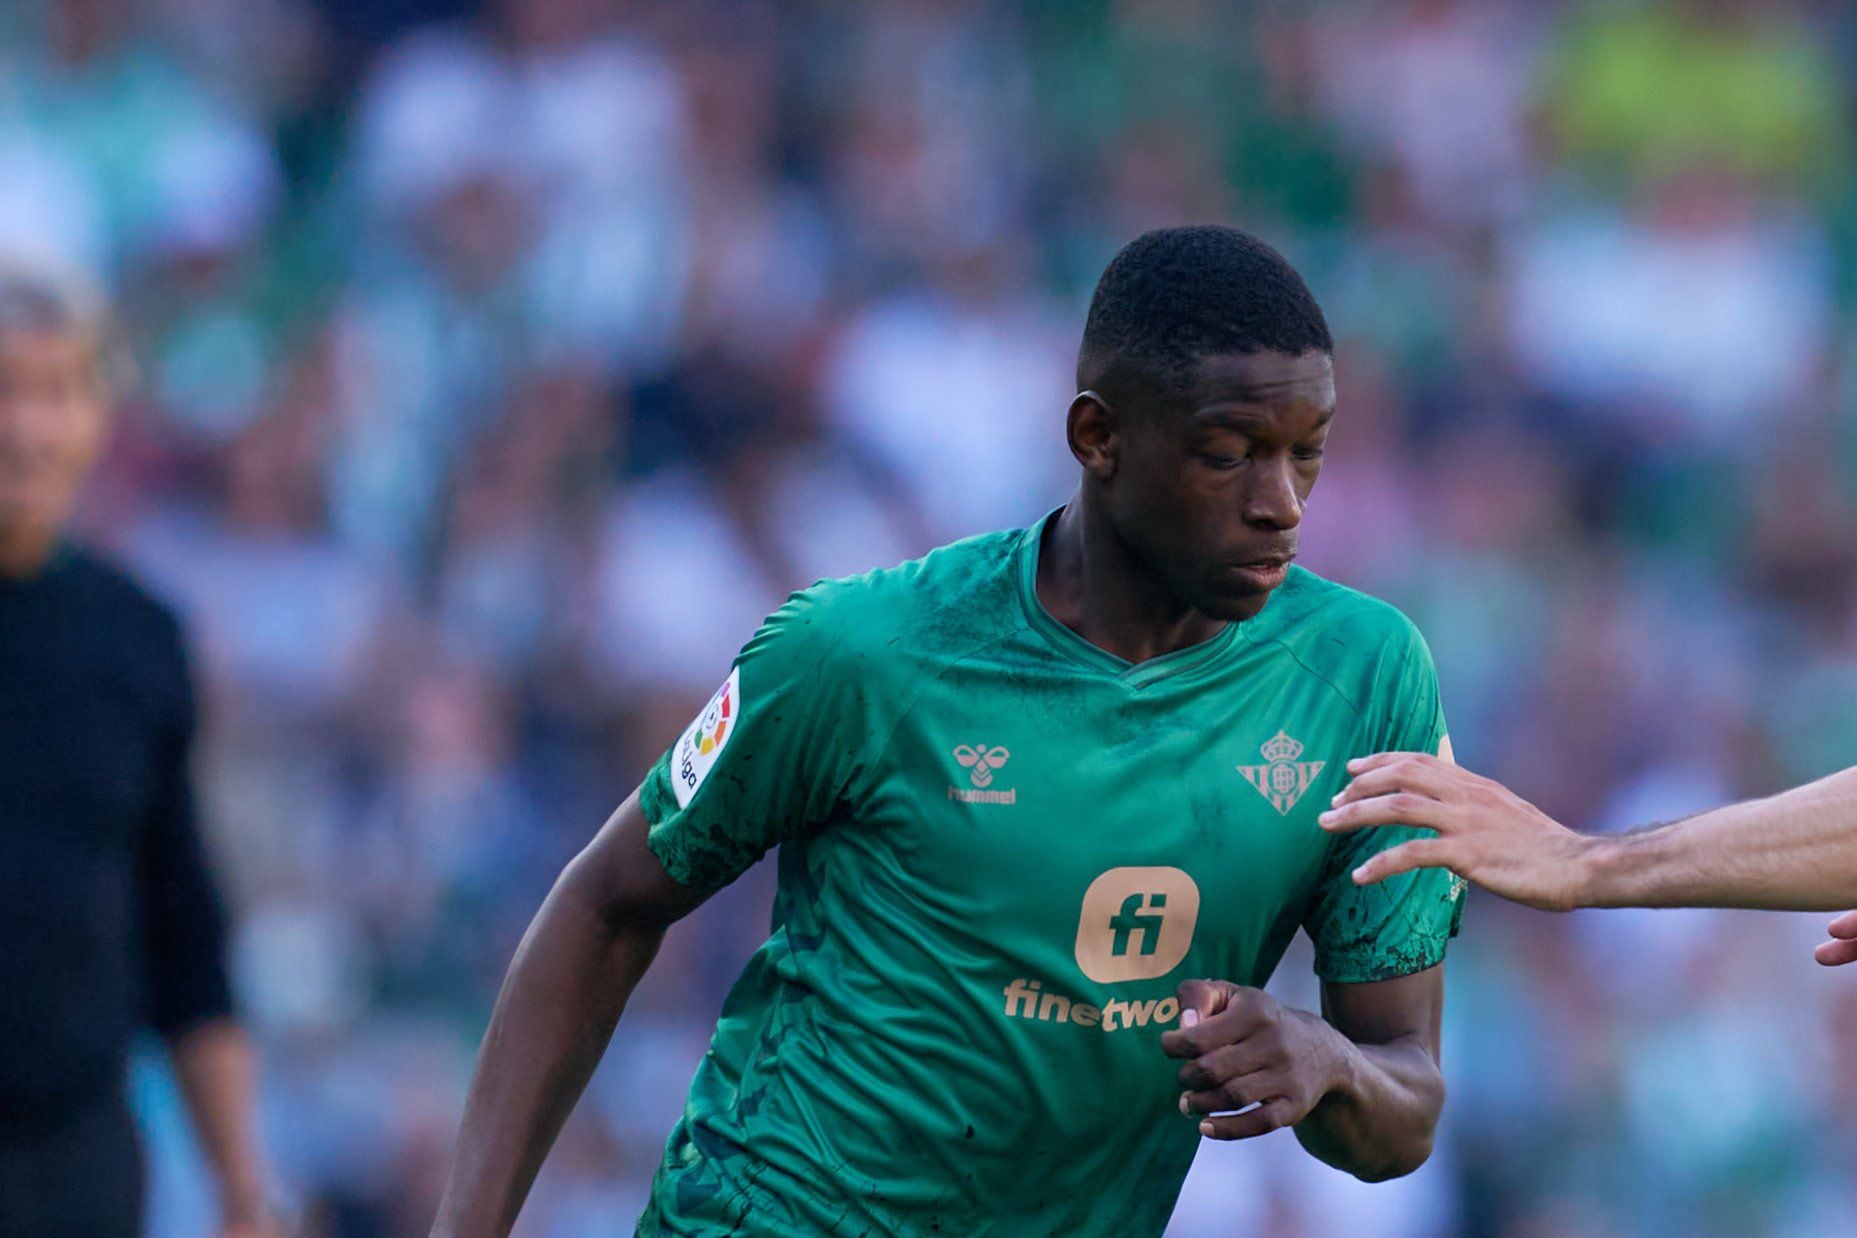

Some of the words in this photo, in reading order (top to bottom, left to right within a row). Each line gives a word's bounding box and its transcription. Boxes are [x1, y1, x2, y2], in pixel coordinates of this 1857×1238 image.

[947, 785, 1017, 805] hummel
[1108, 893, 1168, 957] fi
[1003, 978, 1179, 1032] finetwo
